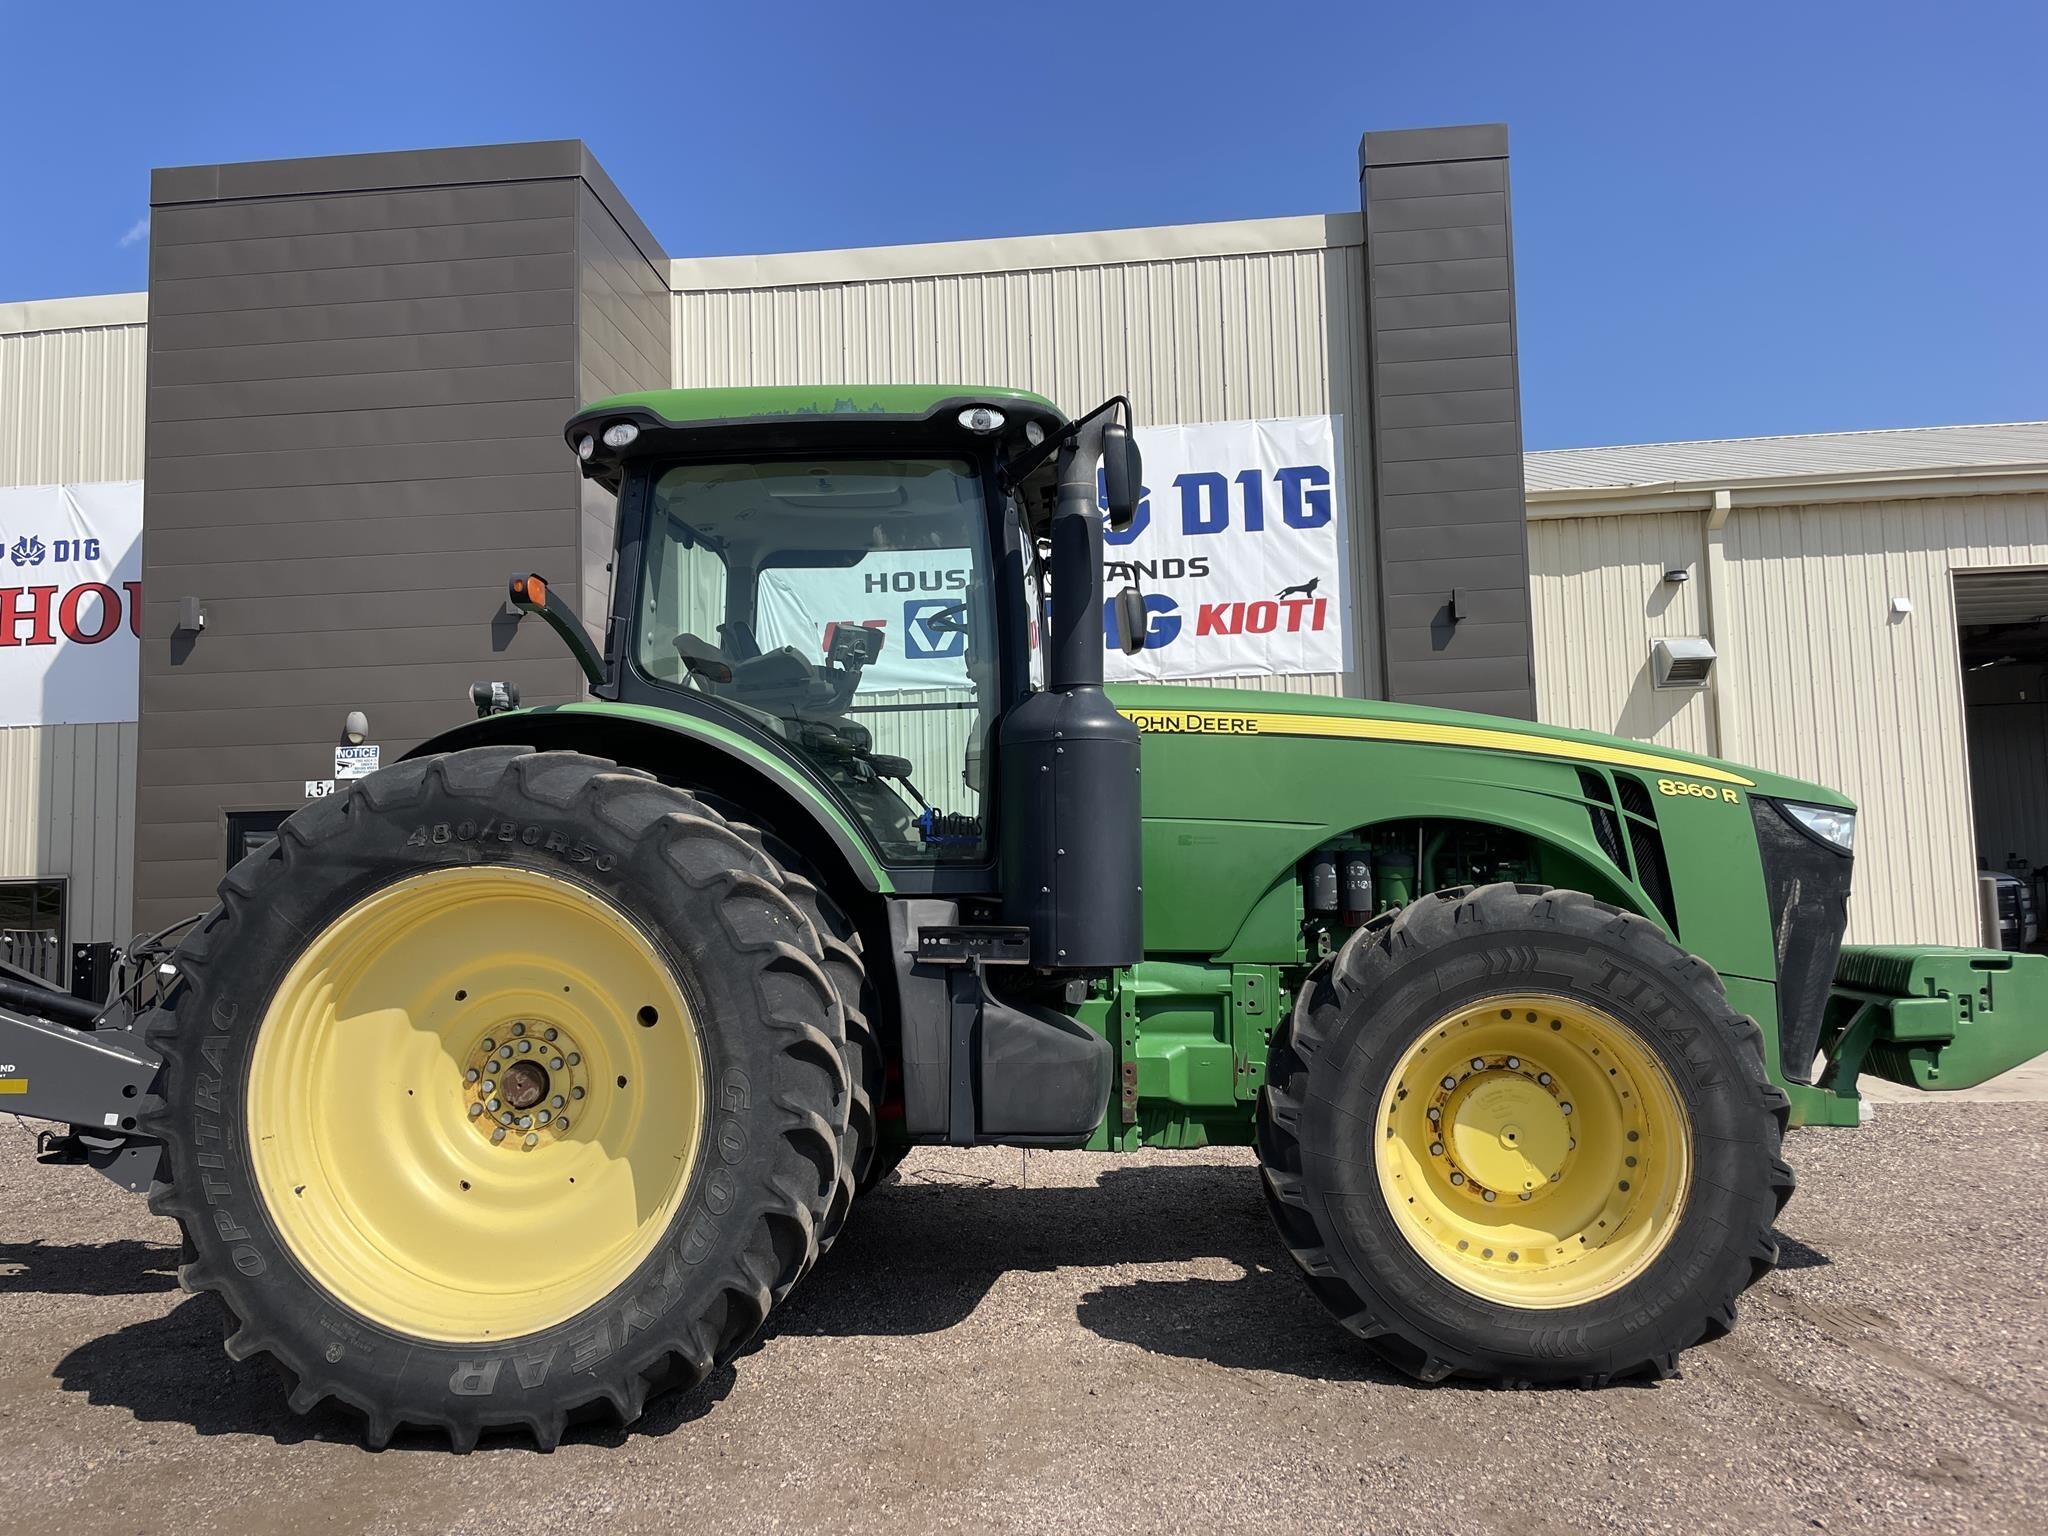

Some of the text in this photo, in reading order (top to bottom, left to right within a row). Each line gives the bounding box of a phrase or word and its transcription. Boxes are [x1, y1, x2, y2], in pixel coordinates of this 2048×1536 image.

[865, 569, 974, 593] HOUS
[1196, 598, 1327, 636] KIOTI
[1187, 714, 1258, 732] DEERE
[337, 748, 377, 758] NOTICE
[1657, 778, 1740, 804] 8360 R
[1591, 957, 1729, 1094] TITAN
[195, 993, 267, 1277] OPTITRAC
[449, 1067, 751, 1396] GOODYEAR
